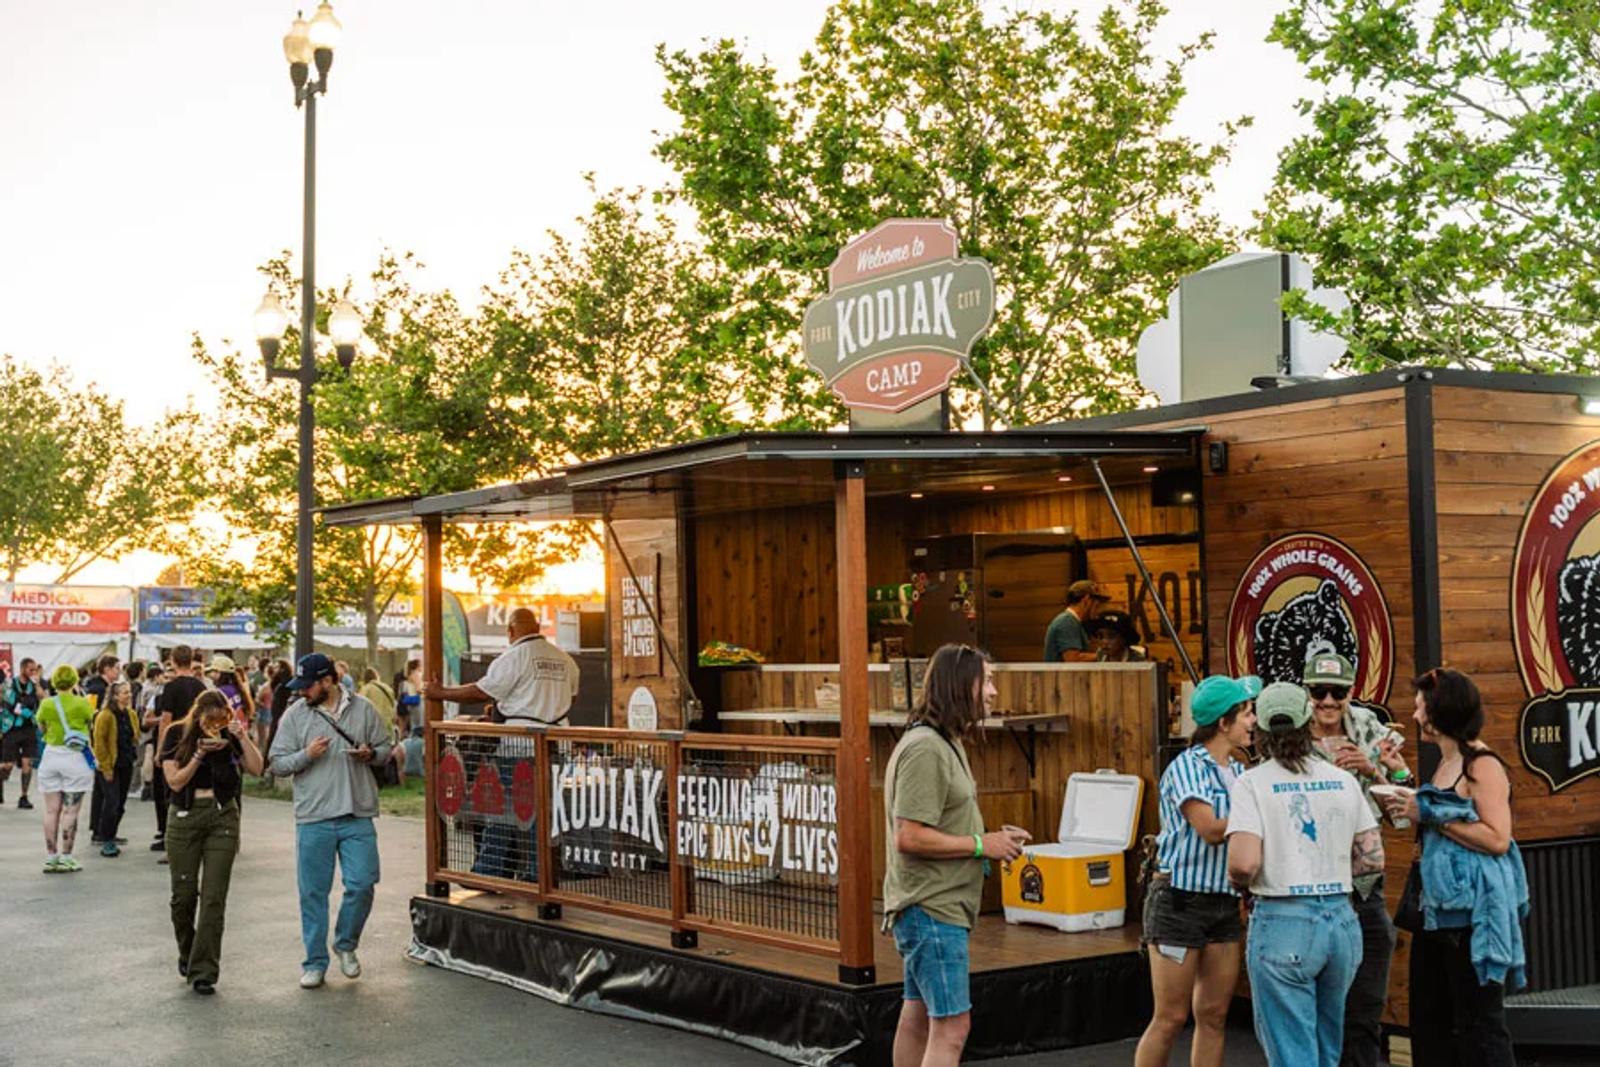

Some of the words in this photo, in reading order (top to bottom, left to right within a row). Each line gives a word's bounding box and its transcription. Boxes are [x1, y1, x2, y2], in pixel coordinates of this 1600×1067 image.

[856, 244, 909, 272] Welcome
[912, 236, 925, 257] to
[836, 273, 956, 363] KODIAK
[957, 289, 981, 310] CITY
[866, 361, 922, 392] CAMP
[1549, 481, 1586, 529] 100%
[1270, 549, 1317, 572] WHOLE
[1318, 553, 1363, 596] GRAINS
[11, 592, 88, 605] MEDICAL
[7, 609, 56, 624] FIRST
[59, 611, 91, 626] AID
[1531, 726, 1561, 744] PARK
[677, 775, 751, 821] FEEDING
[782, 783, 837, 823] WILDER
[1304, 781, 1344, 792] LEAGUE
[551, 765, 664, 852] KODIAK
[565, 846, 601, 865] PARK
[611, 853, 647, 871] CITY
[677, 820, 708, 857] EPIC
[713, 822, 751, 863] DAYS
